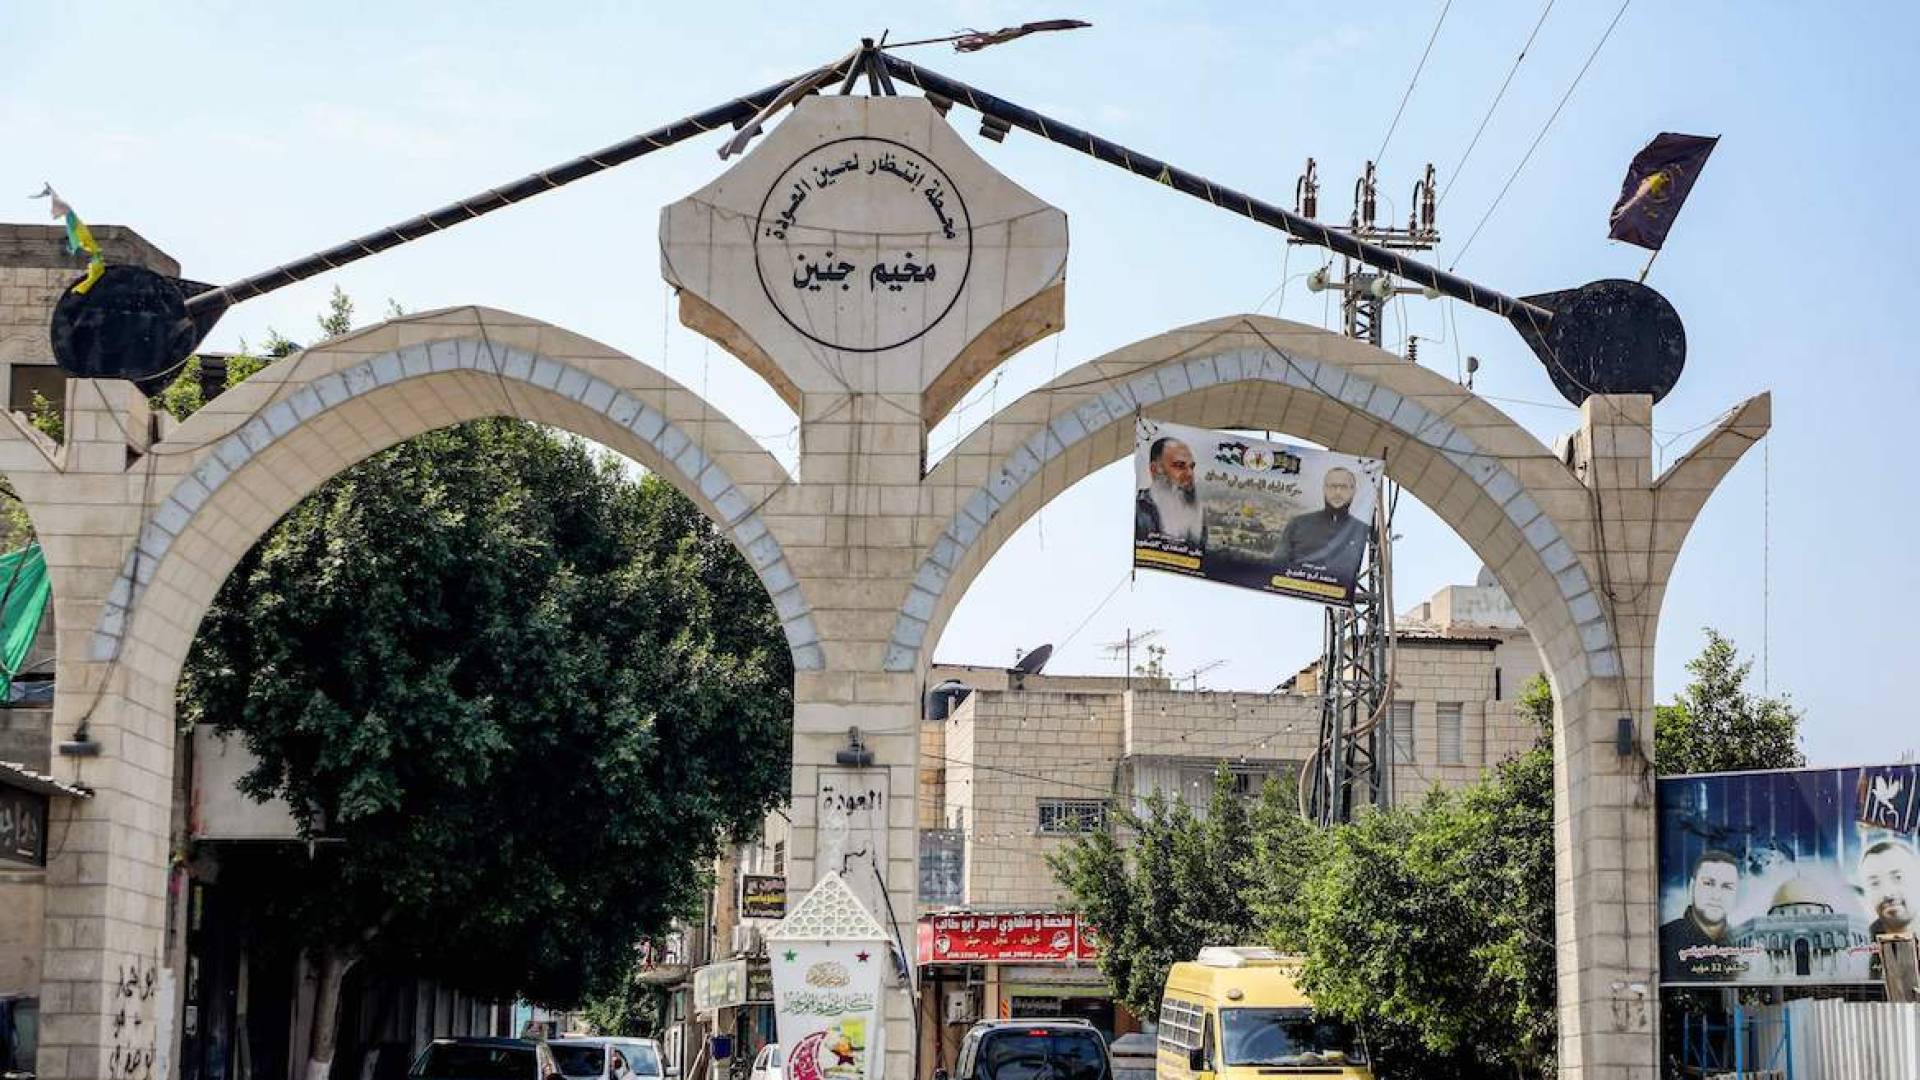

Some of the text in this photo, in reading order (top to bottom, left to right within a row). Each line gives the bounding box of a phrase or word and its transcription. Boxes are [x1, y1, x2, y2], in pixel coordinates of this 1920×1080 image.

[765, 179, 813, 240] العودة
[924, 179, 956, 239] محطة
[793, 251, 937, 293] مخيم جنين
[935, 917, 961, 933] طالب
[976, 916, 998, 932] ناصر
[1035, 918, 1042, 931] و
[1043, 915, 1073, 928] ملحمة
